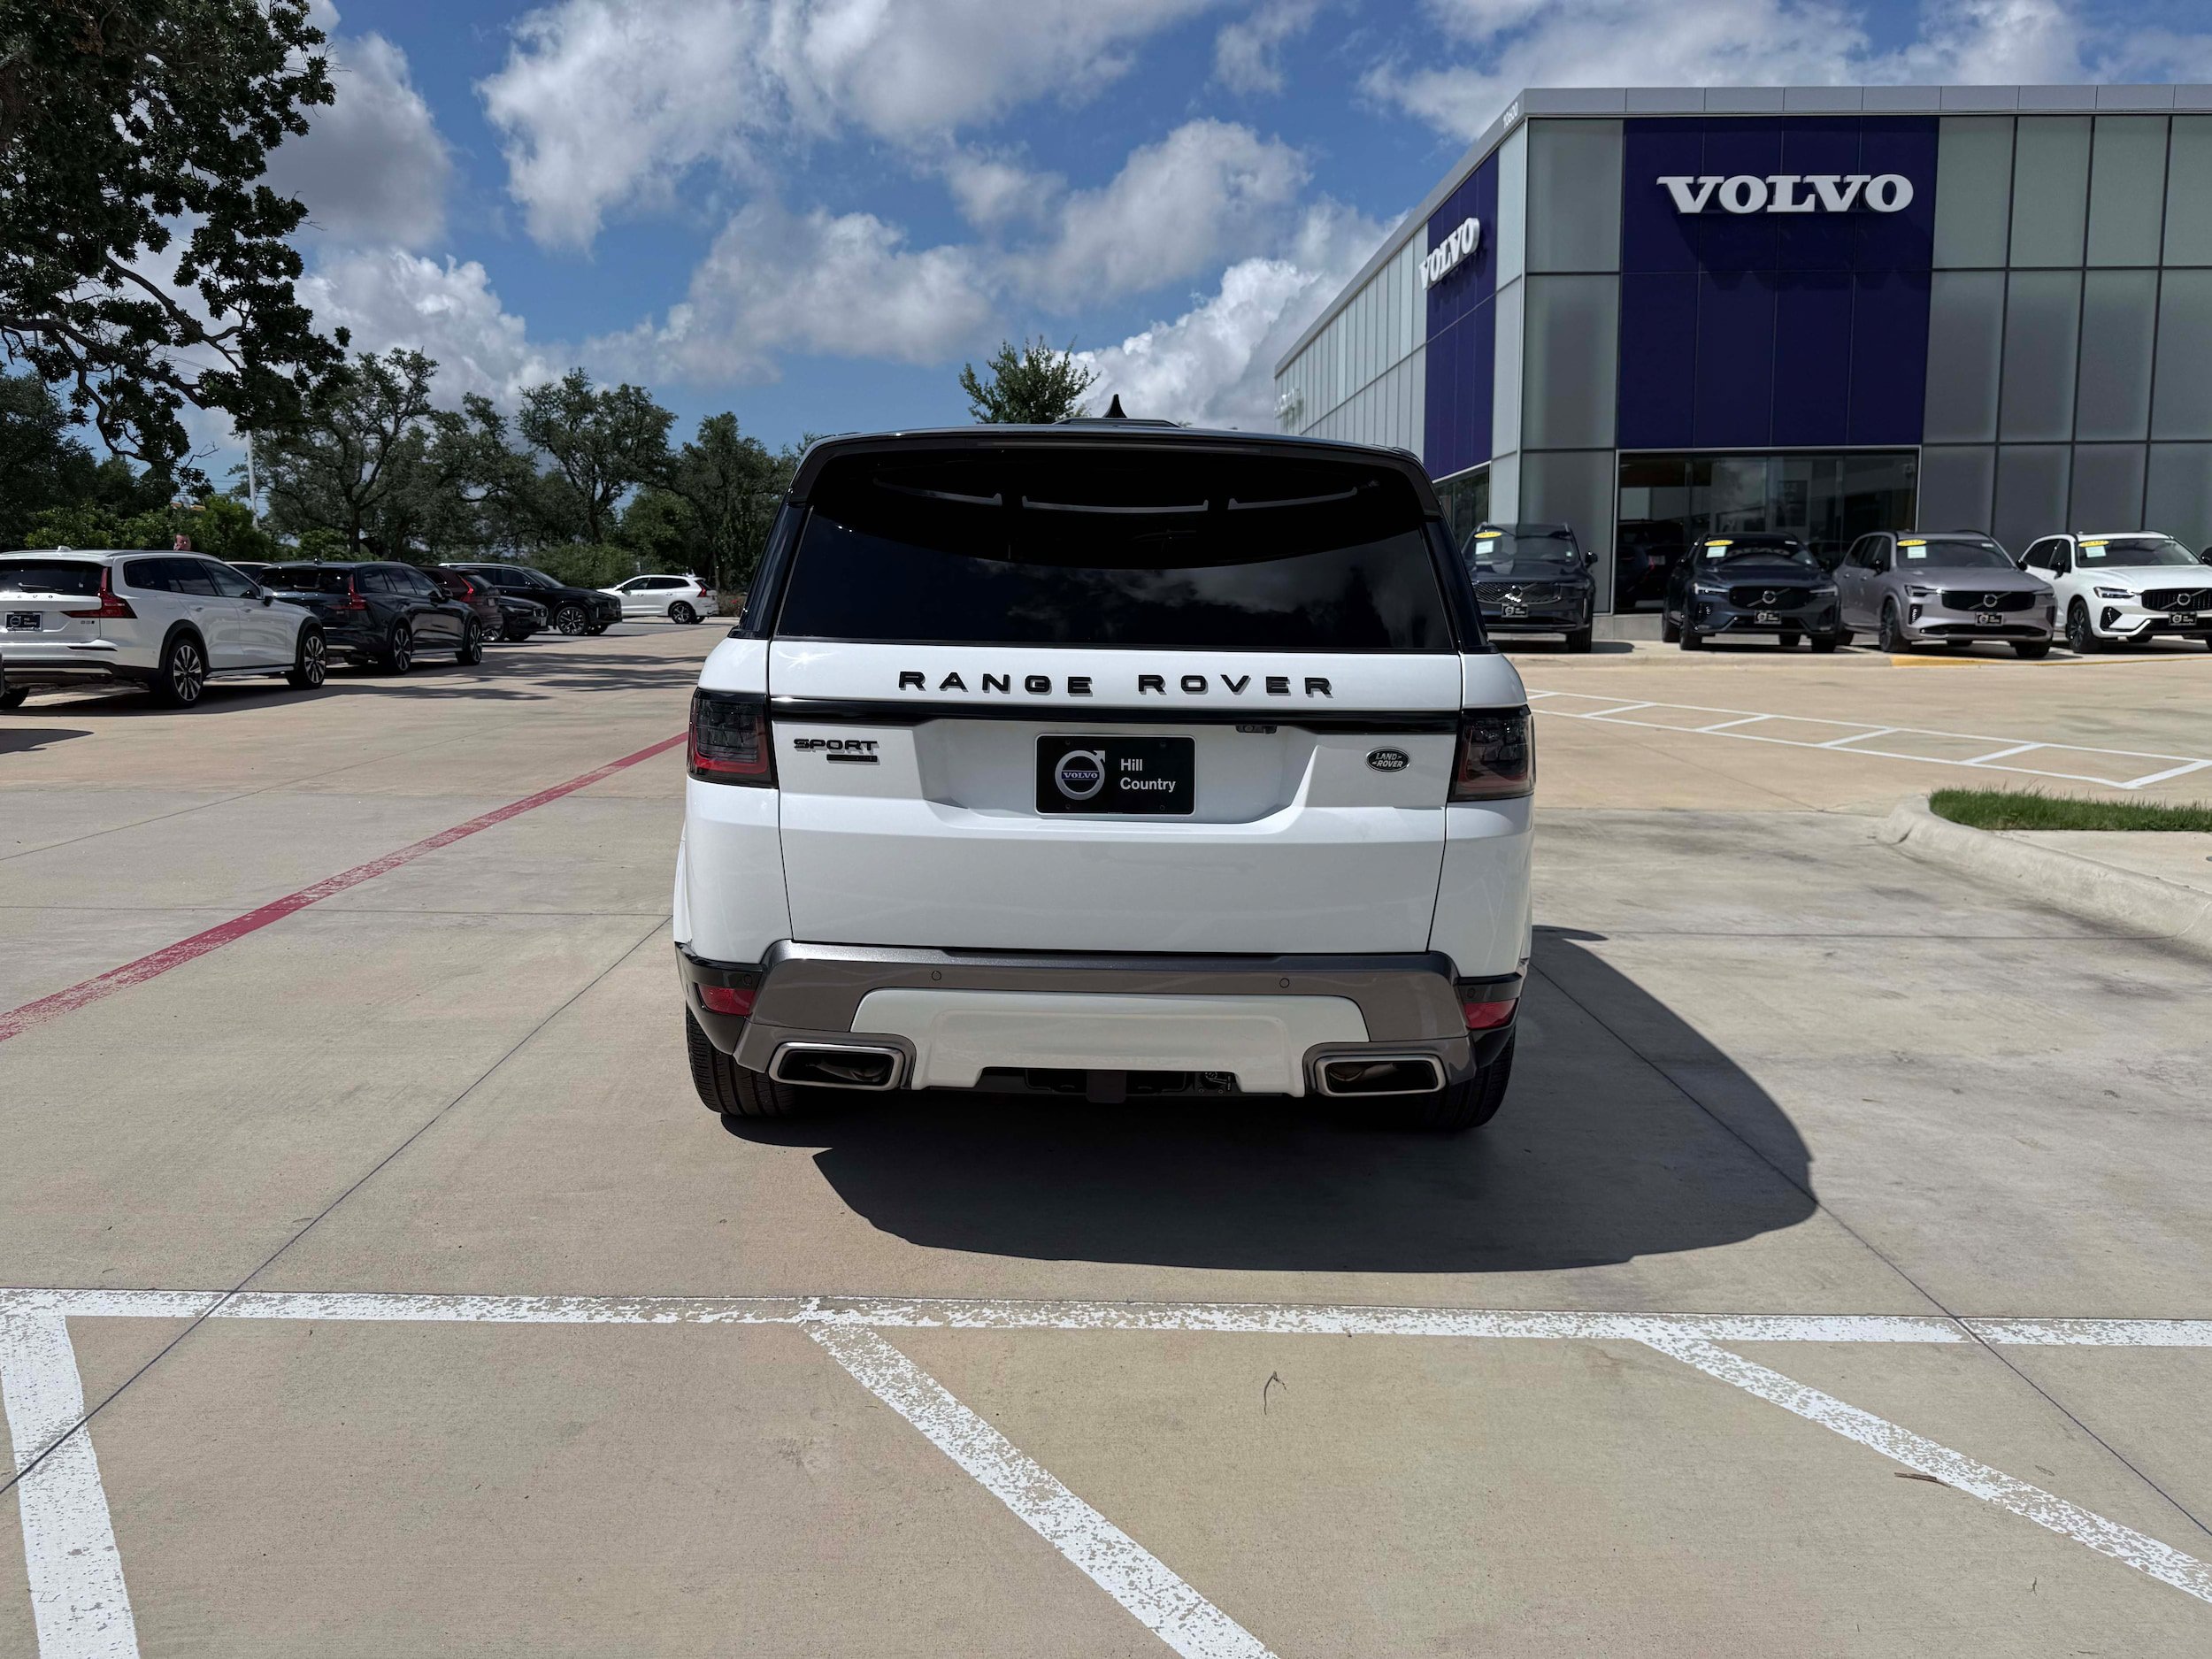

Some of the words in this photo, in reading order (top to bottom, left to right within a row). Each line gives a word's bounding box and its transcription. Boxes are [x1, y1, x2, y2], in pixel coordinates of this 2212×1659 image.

[1656, 174, 1914, 213] VOLVO
[1418, 218, 1480, 290] VOLVO
[899, 671, 1093, 695] RANGE
[1138, 674, 1333, 696] ROVER
[794, 739, 879, 751] SPORT
[1120, 758, 1143, 772] Hill
[1119, 777, 1177, 793] Country
